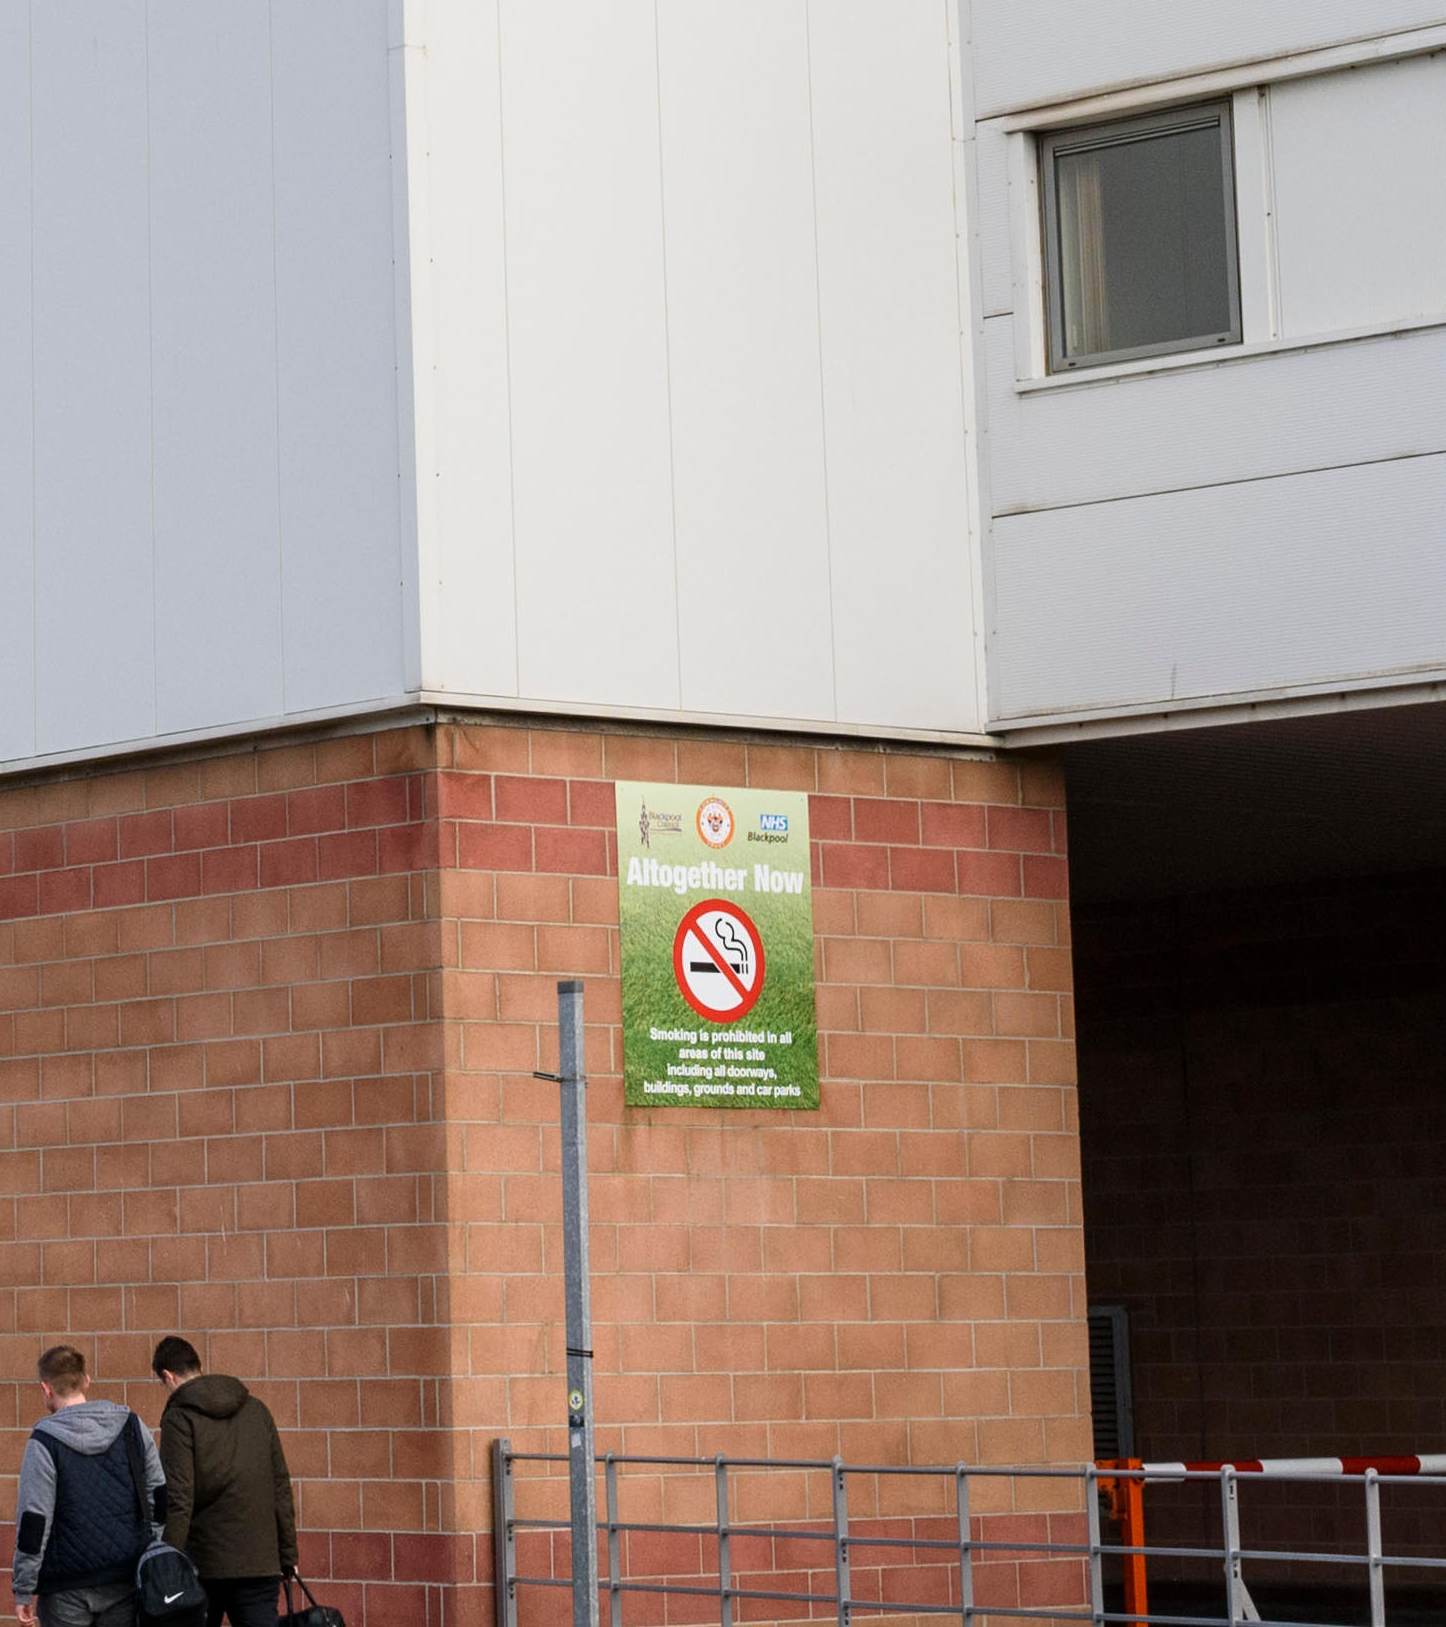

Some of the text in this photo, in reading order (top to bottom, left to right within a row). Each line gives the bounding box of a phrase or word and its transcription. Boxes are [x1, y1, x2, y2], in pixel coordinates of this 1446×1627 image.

[762, 815, 787, 830] NHS
[747, 831, 789, 844] Blackpool
[626, 856, 805, 895] Altogether Now
[649, 1027, 792, 1045] Smoking is prohibited in all
[679, 1047, 766, 1061] areas of this site
[667, 1063, 778, 1081] including all doorways,
[643, 1080, 801, 1098] buildings, grounds and car parks
